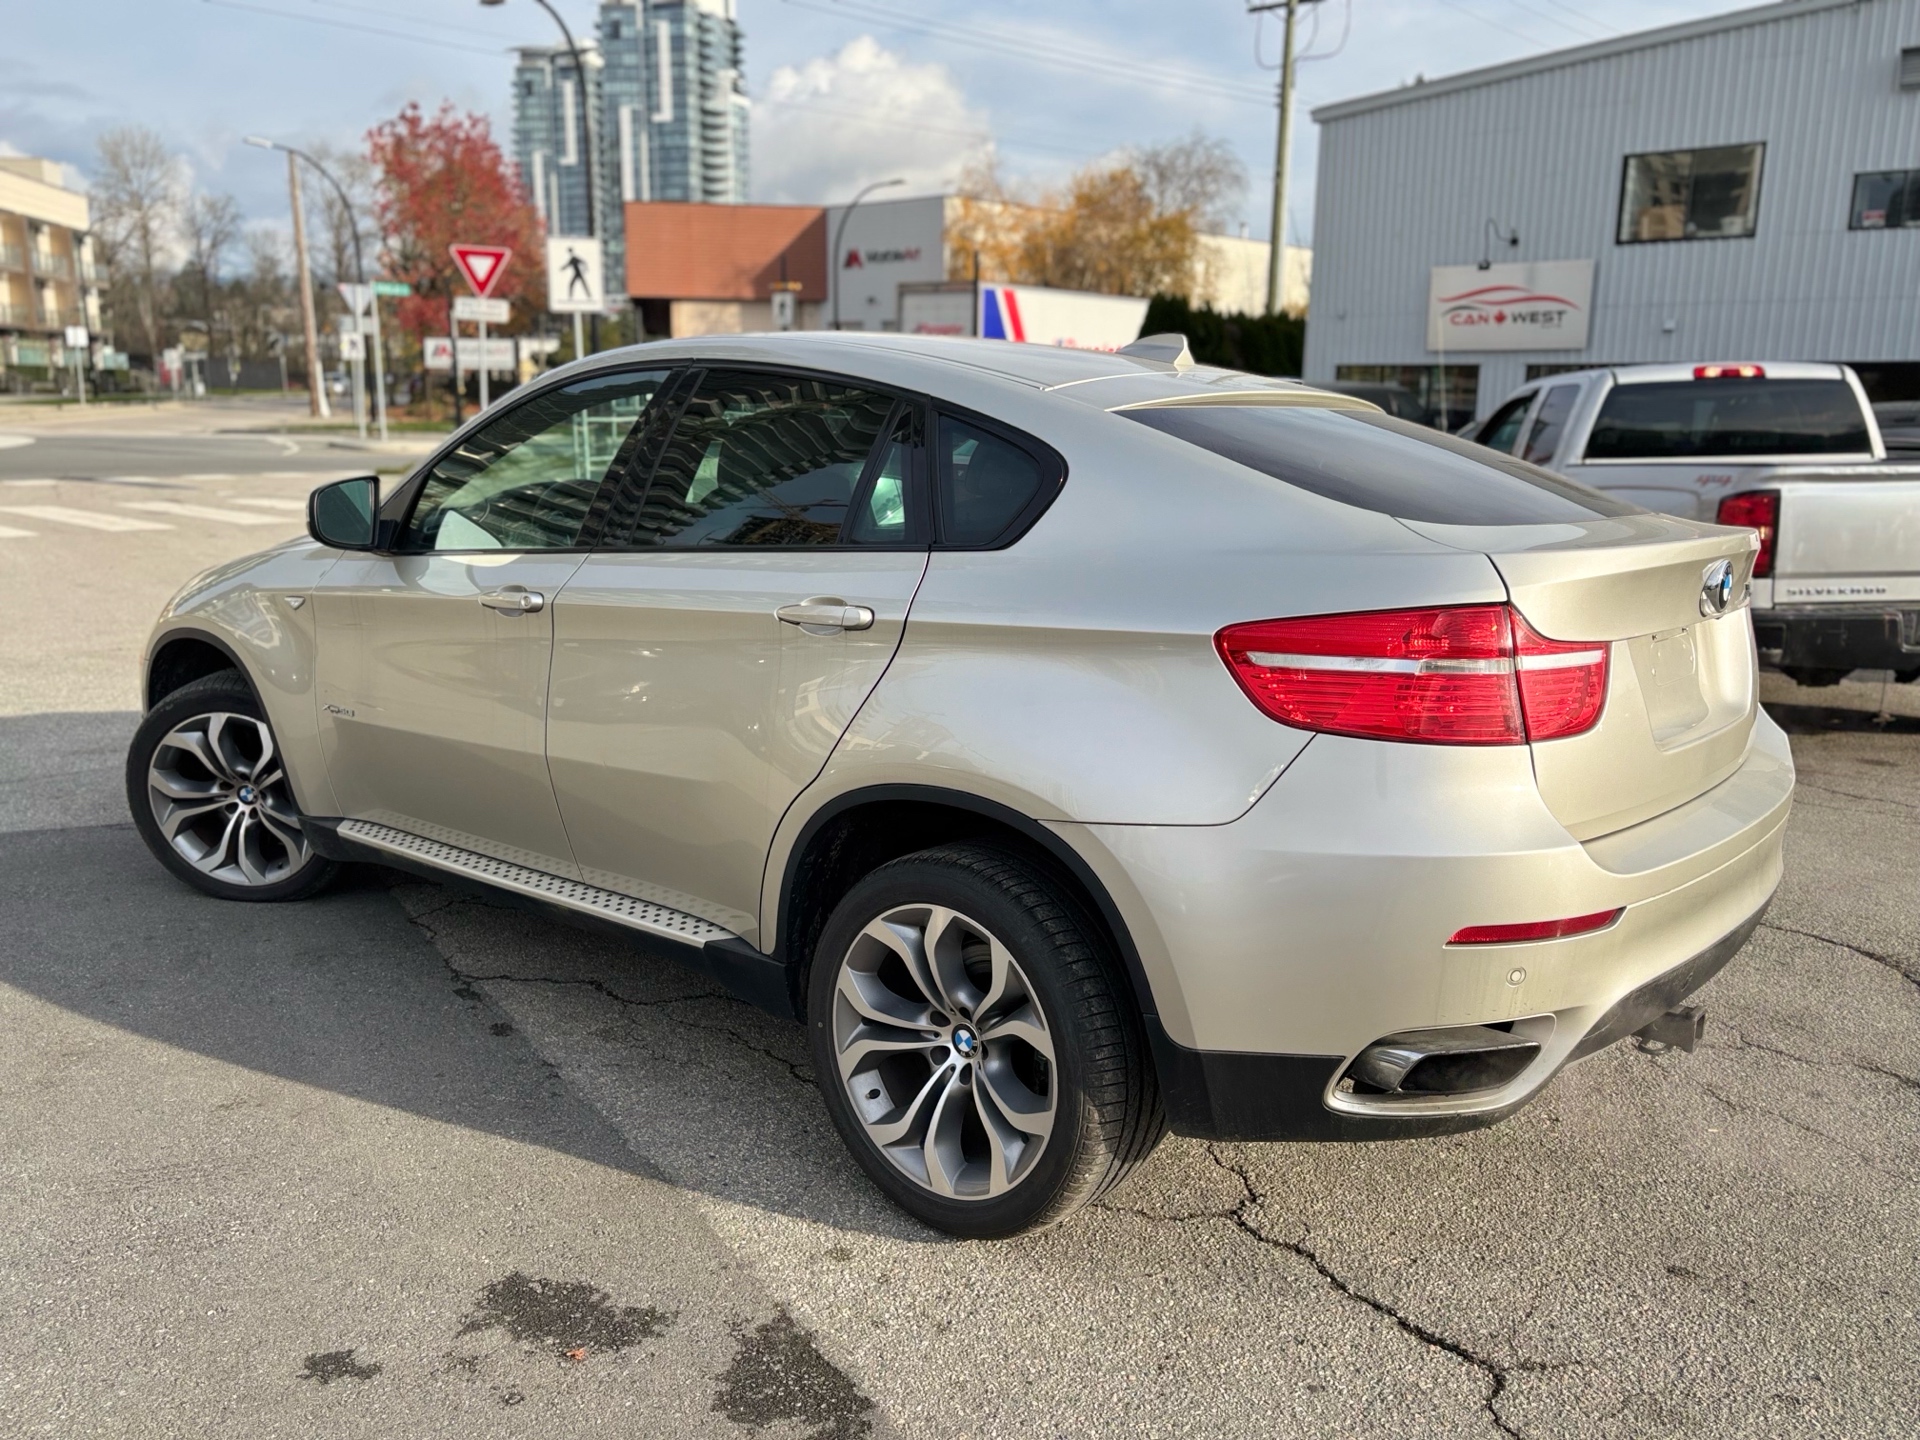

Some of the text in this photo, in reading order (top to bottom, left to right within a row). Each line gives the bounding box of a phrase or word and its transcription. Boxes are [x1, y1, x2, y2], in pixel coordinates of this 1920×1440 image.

[1449, 310, 1566, 326] CAN WEST
[1785, 586, 1887, 597] SILVERADO
